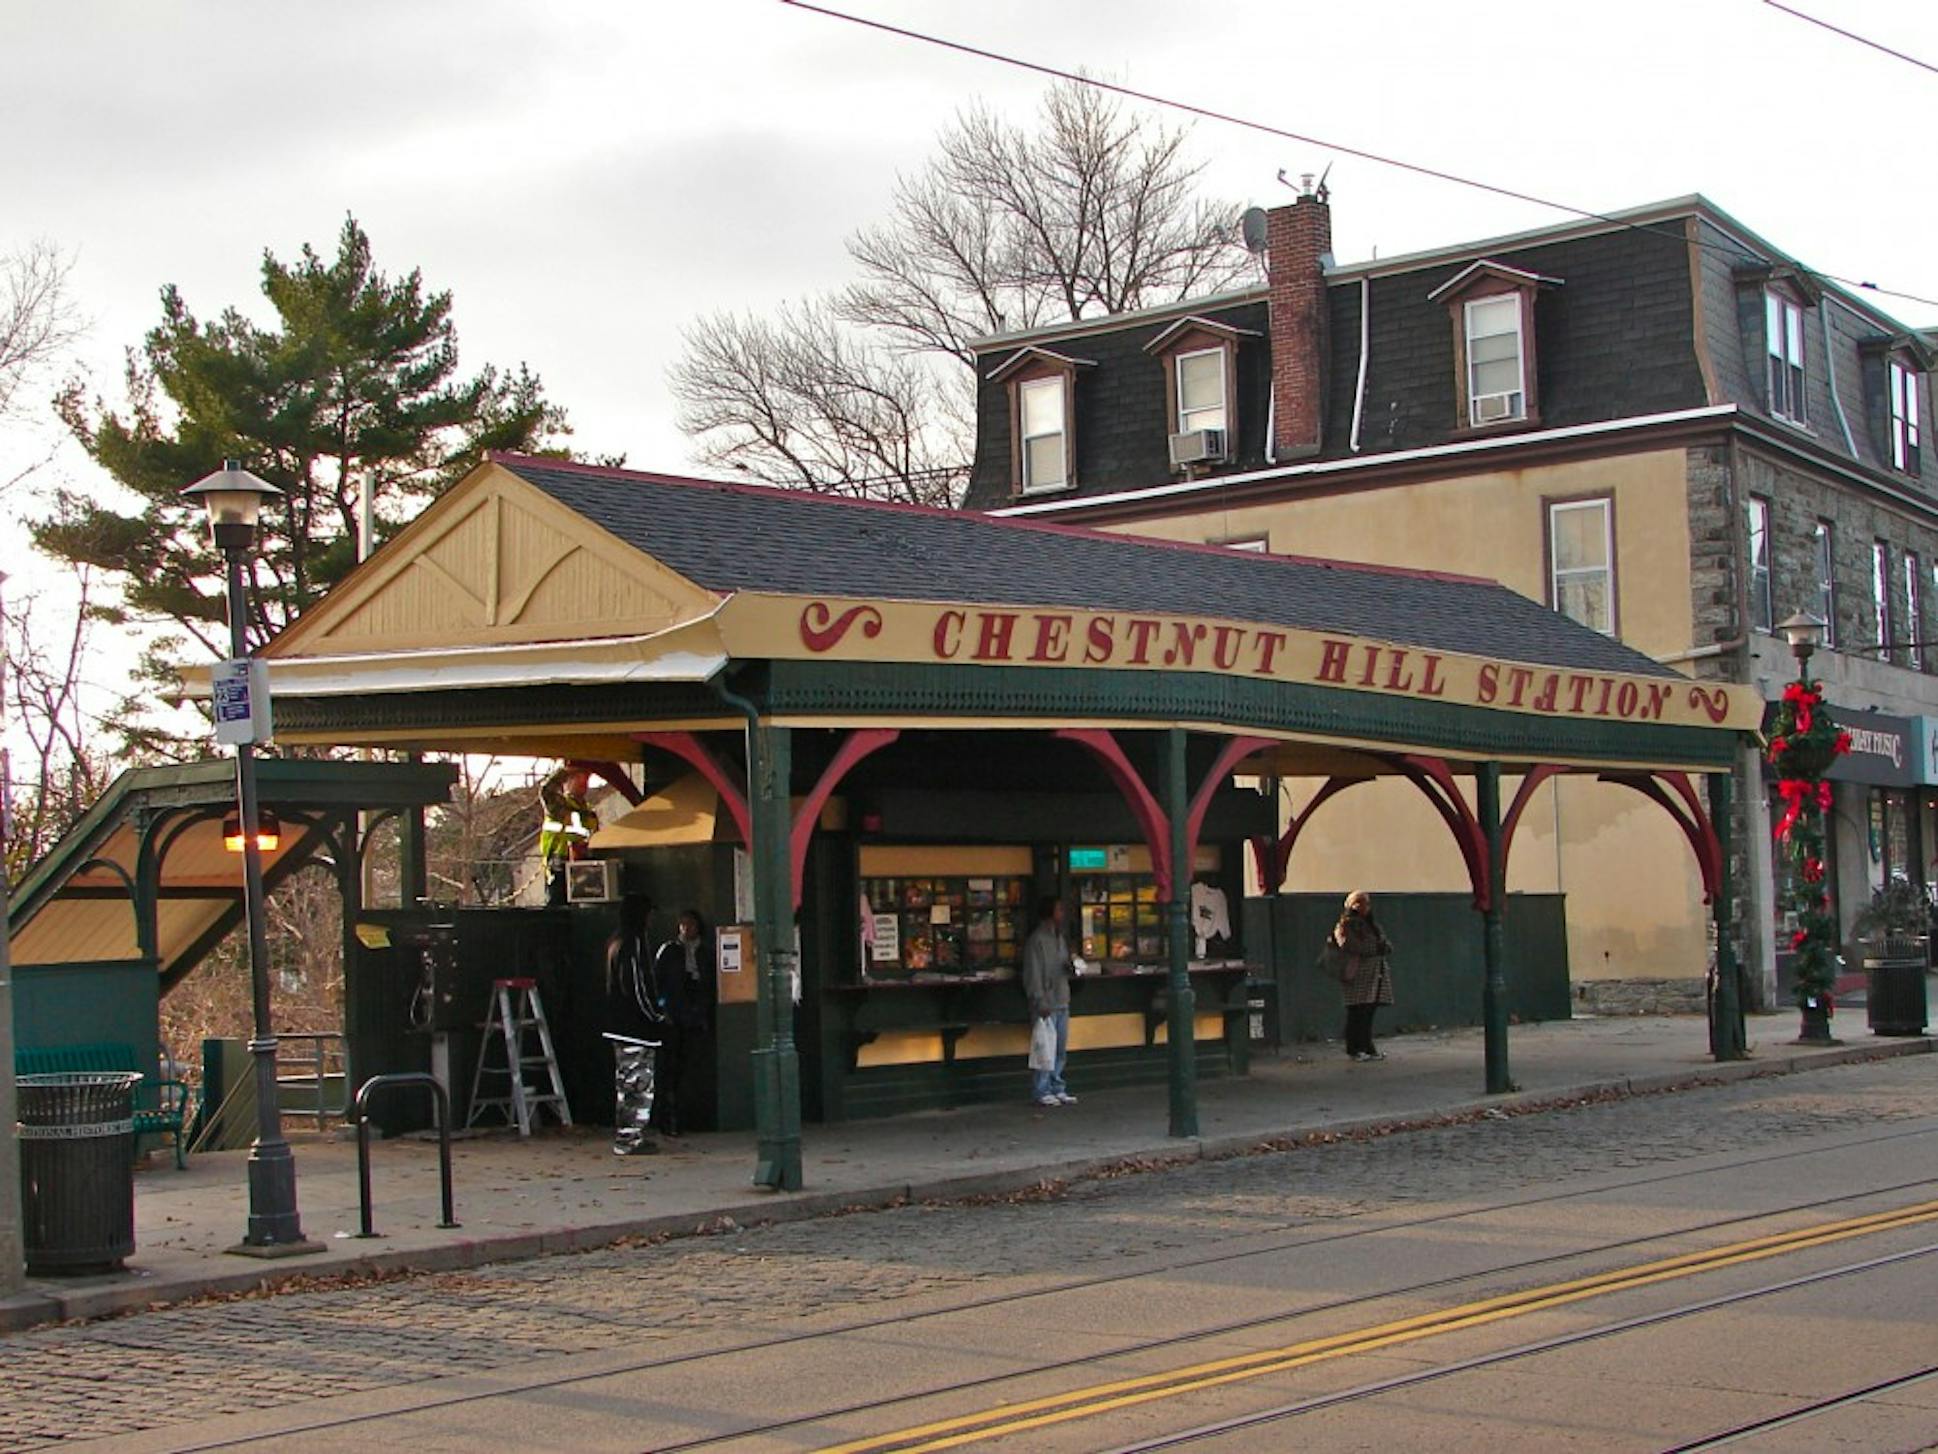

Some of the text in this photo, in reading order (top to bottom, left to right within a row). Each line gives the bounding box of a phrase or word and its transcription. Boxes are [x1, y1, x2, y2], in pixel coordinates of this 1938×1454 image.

[932, 611, 1672, 721] CHESTNUT HILL STATION
